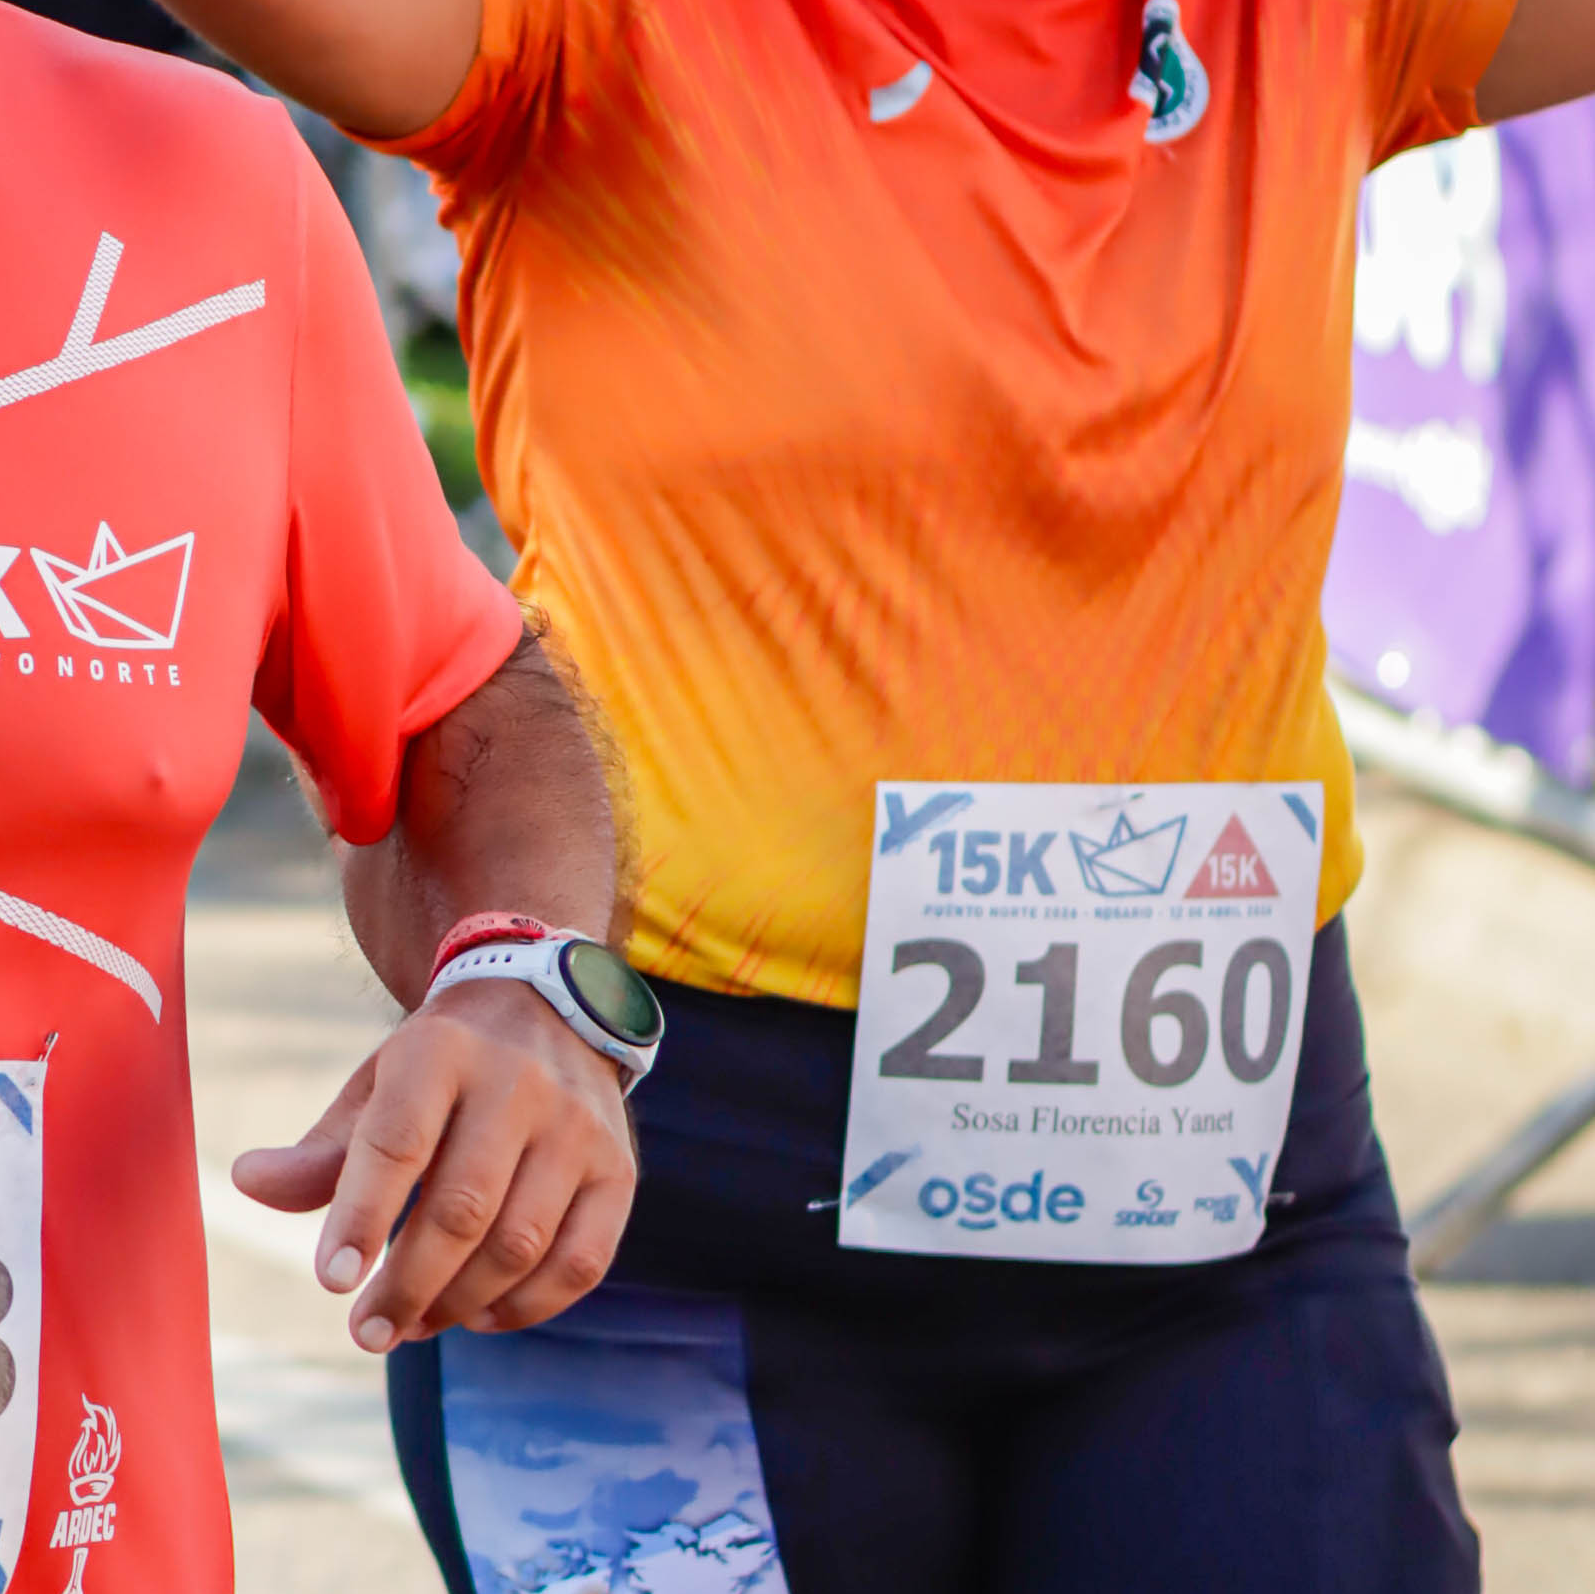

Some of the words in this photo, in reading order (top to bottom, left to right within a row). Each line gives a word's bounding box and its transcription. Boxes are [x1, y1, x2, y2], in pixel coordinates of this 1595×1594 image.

[928, 830, 1058, 897] 15K
[1207, 853, 1260, 889] 15K
[878, 937, 1292, 1088] 2160
[951, 1103, 1019, 1133] Sosa
[1030, 1107, 1161, 1136] Florencia
[1171, 1108, 1234, 1135] Yanet
[917, 1169, 1086, 1227] osde
[49, 1503, 116, 1549] ARDEC
